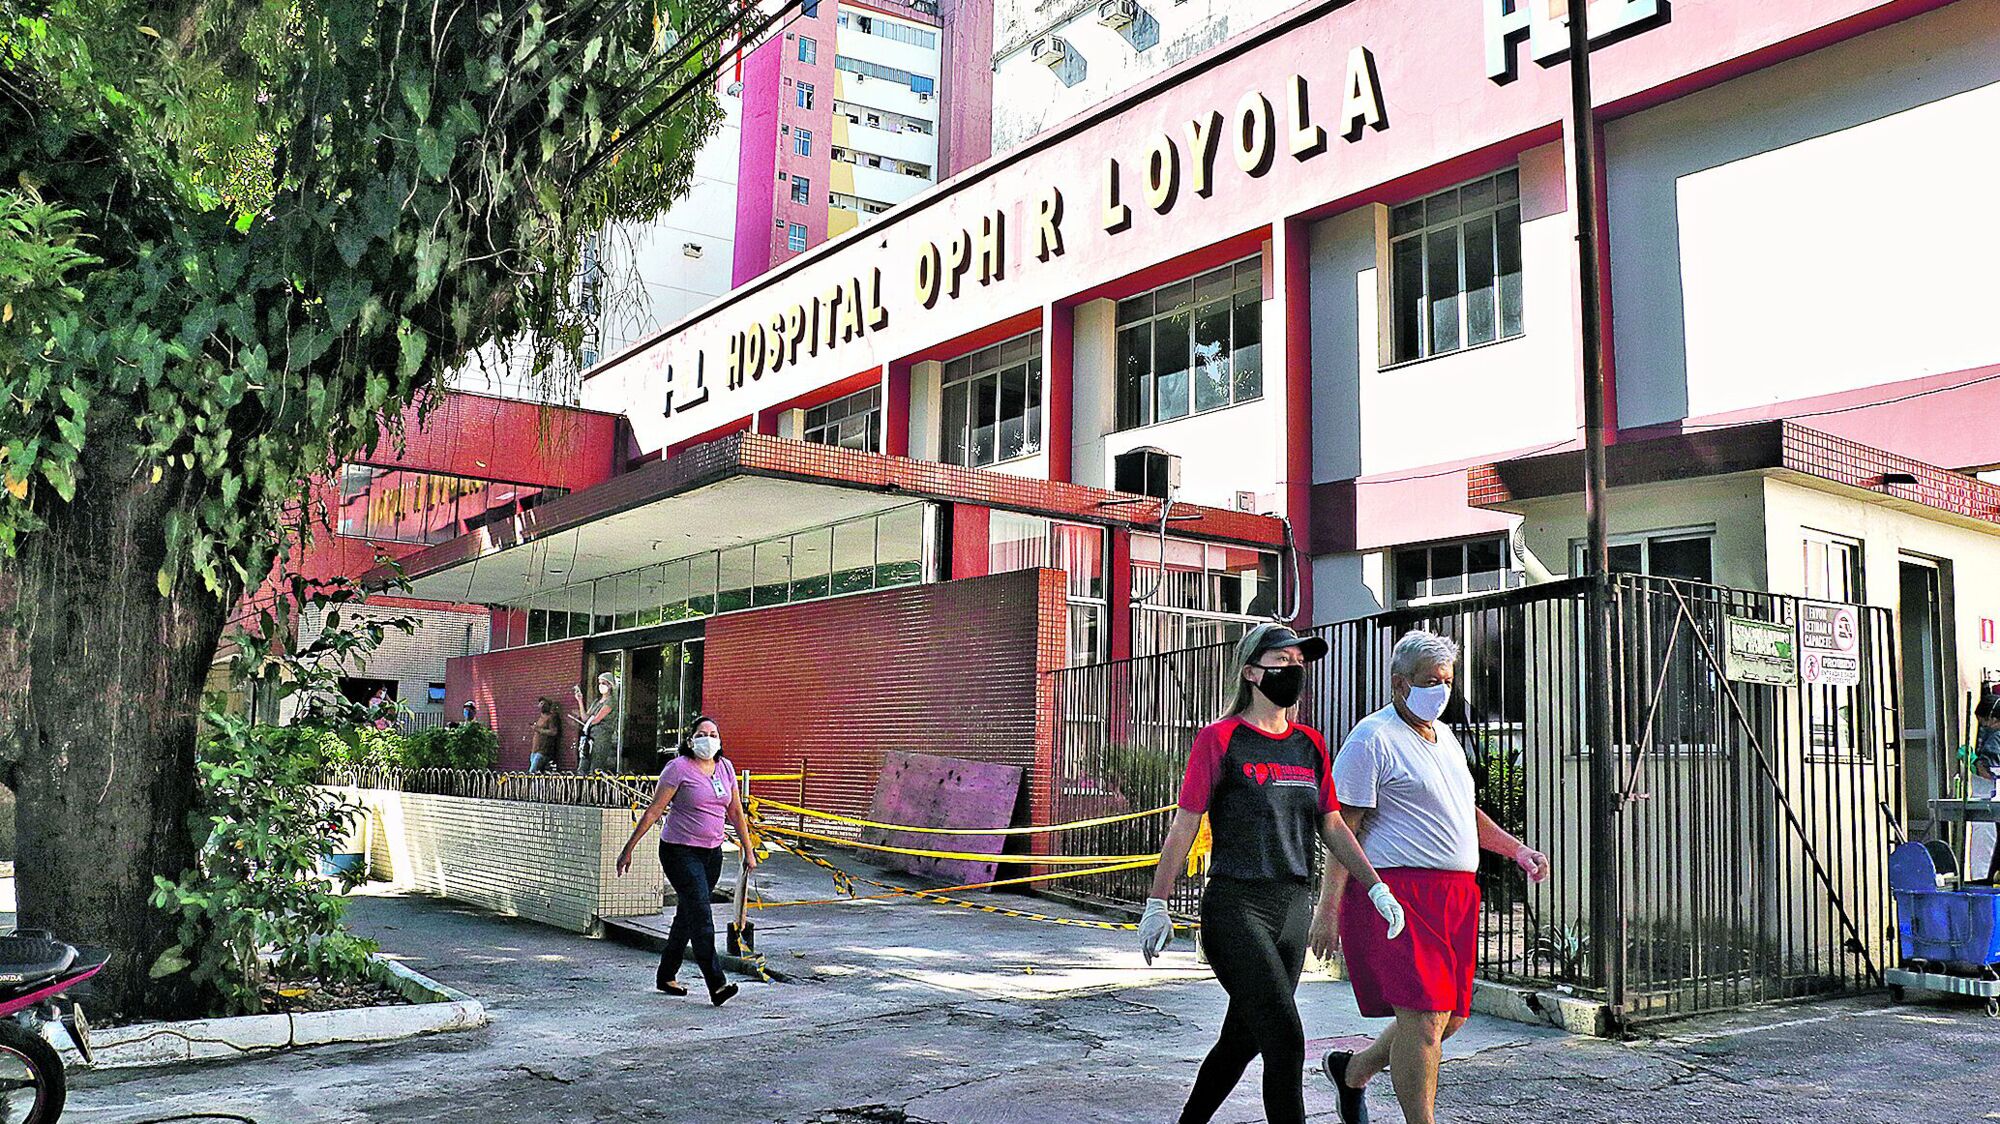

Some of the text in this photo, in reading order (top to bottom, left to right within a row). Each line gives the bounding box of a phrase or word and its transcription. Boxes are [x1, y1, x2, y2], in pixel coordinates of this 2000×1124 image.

[725, 267, 888, 391] HOSPITAL
[1103, 46, 1390, 234] LOYOLA
[0, 973, 23, 982] ONDA
